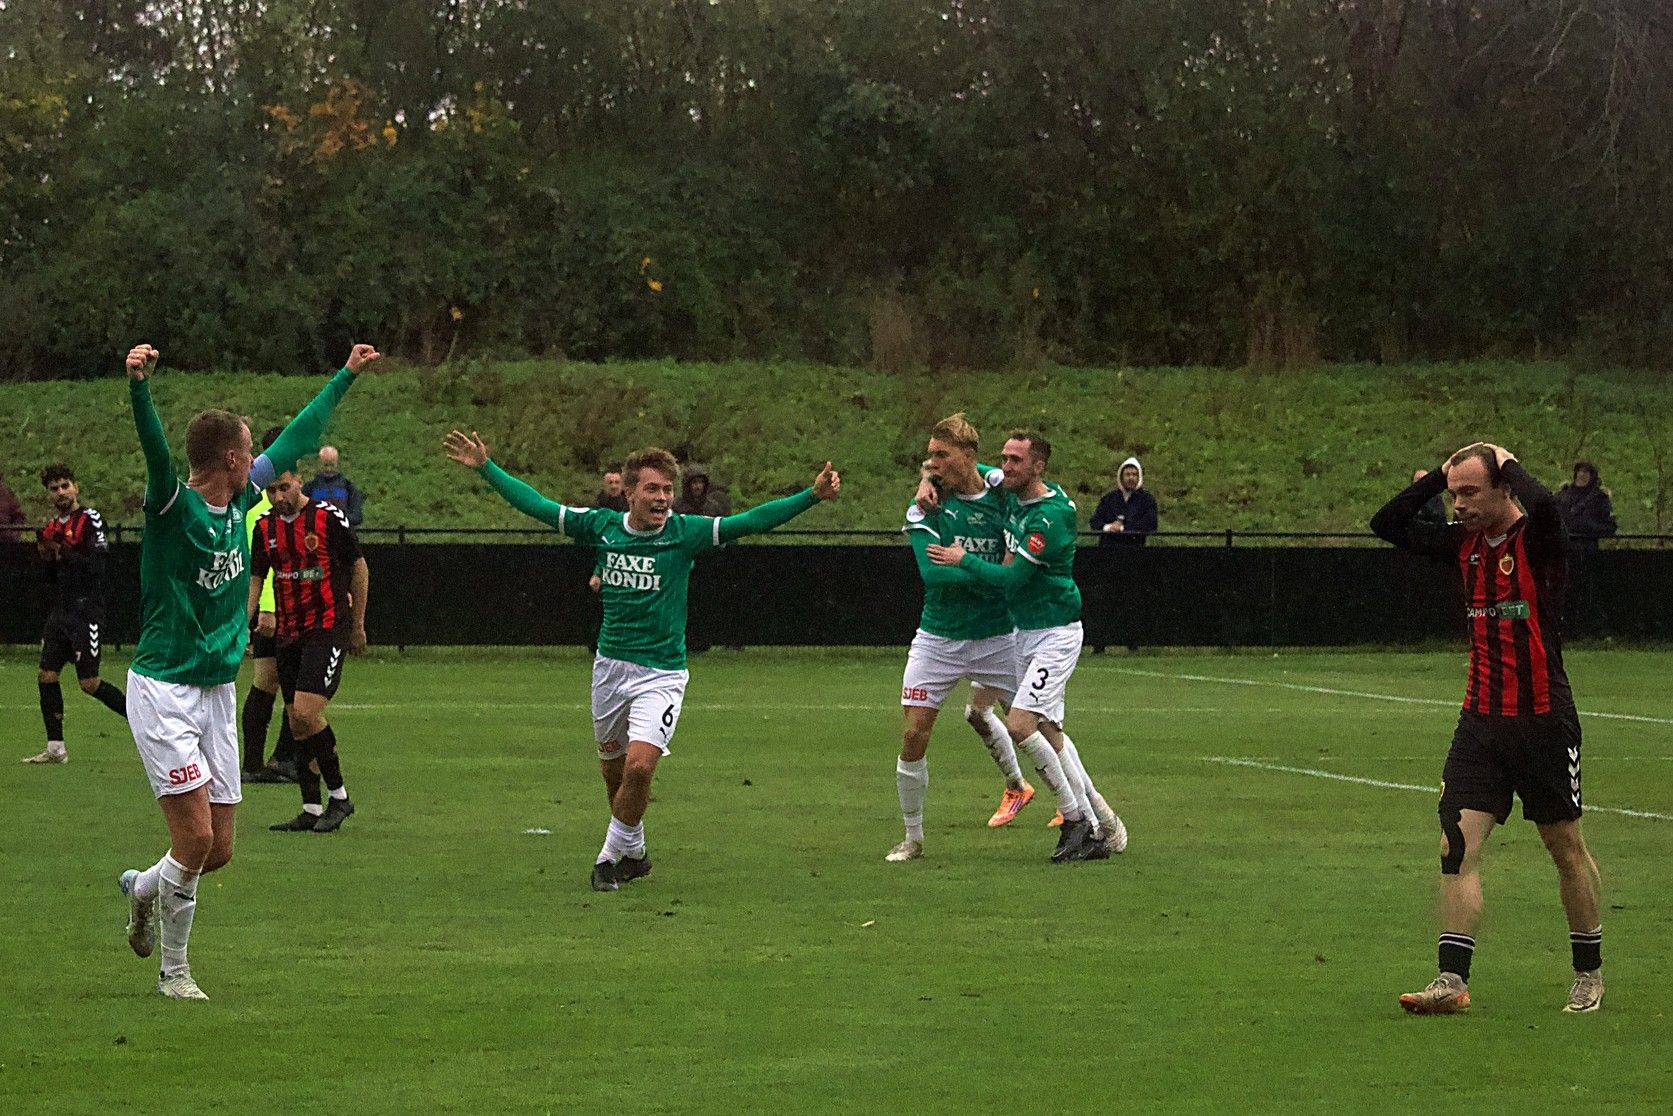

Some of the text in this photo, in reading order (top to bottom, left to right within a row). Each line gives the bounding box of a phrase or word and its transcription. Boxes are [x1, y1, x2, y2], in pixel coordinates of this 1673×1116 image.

[606, 552, 656, 573] FAXE
[602, 567, 661, 590] KONDI
[1031, 667, 1049, 690] 3
[903, 687, 928, 701] SJEB
[662, 704, 675, 727] 6
[169, 763, 202, 785] SJEB
